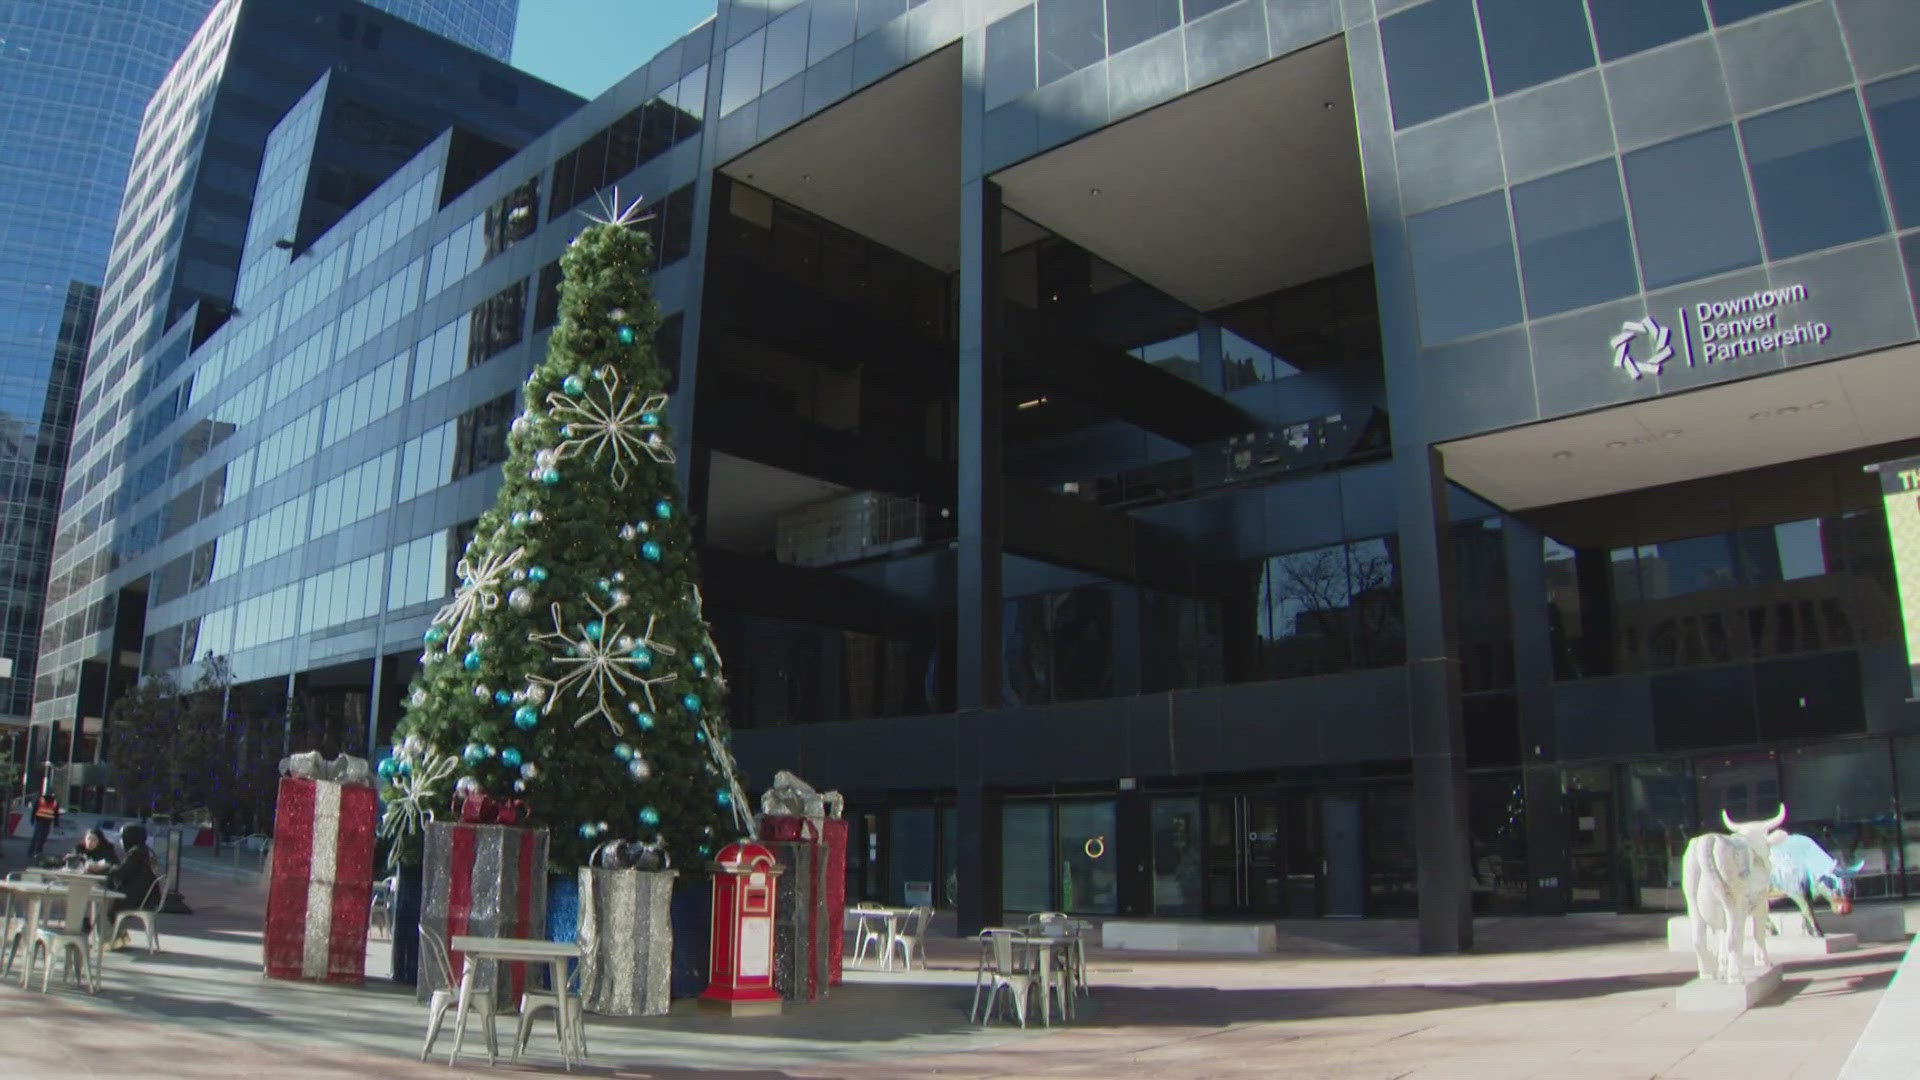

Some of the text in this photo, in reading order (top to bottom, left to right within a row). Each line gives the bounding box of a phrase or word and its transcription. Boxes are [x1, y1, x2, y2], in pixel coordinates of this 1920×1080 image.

[1696, 284, 1807, 321] Downtown
[1700, 311, 1775, 342] Denver
[1704, 322, 1830, 363] Partnership
